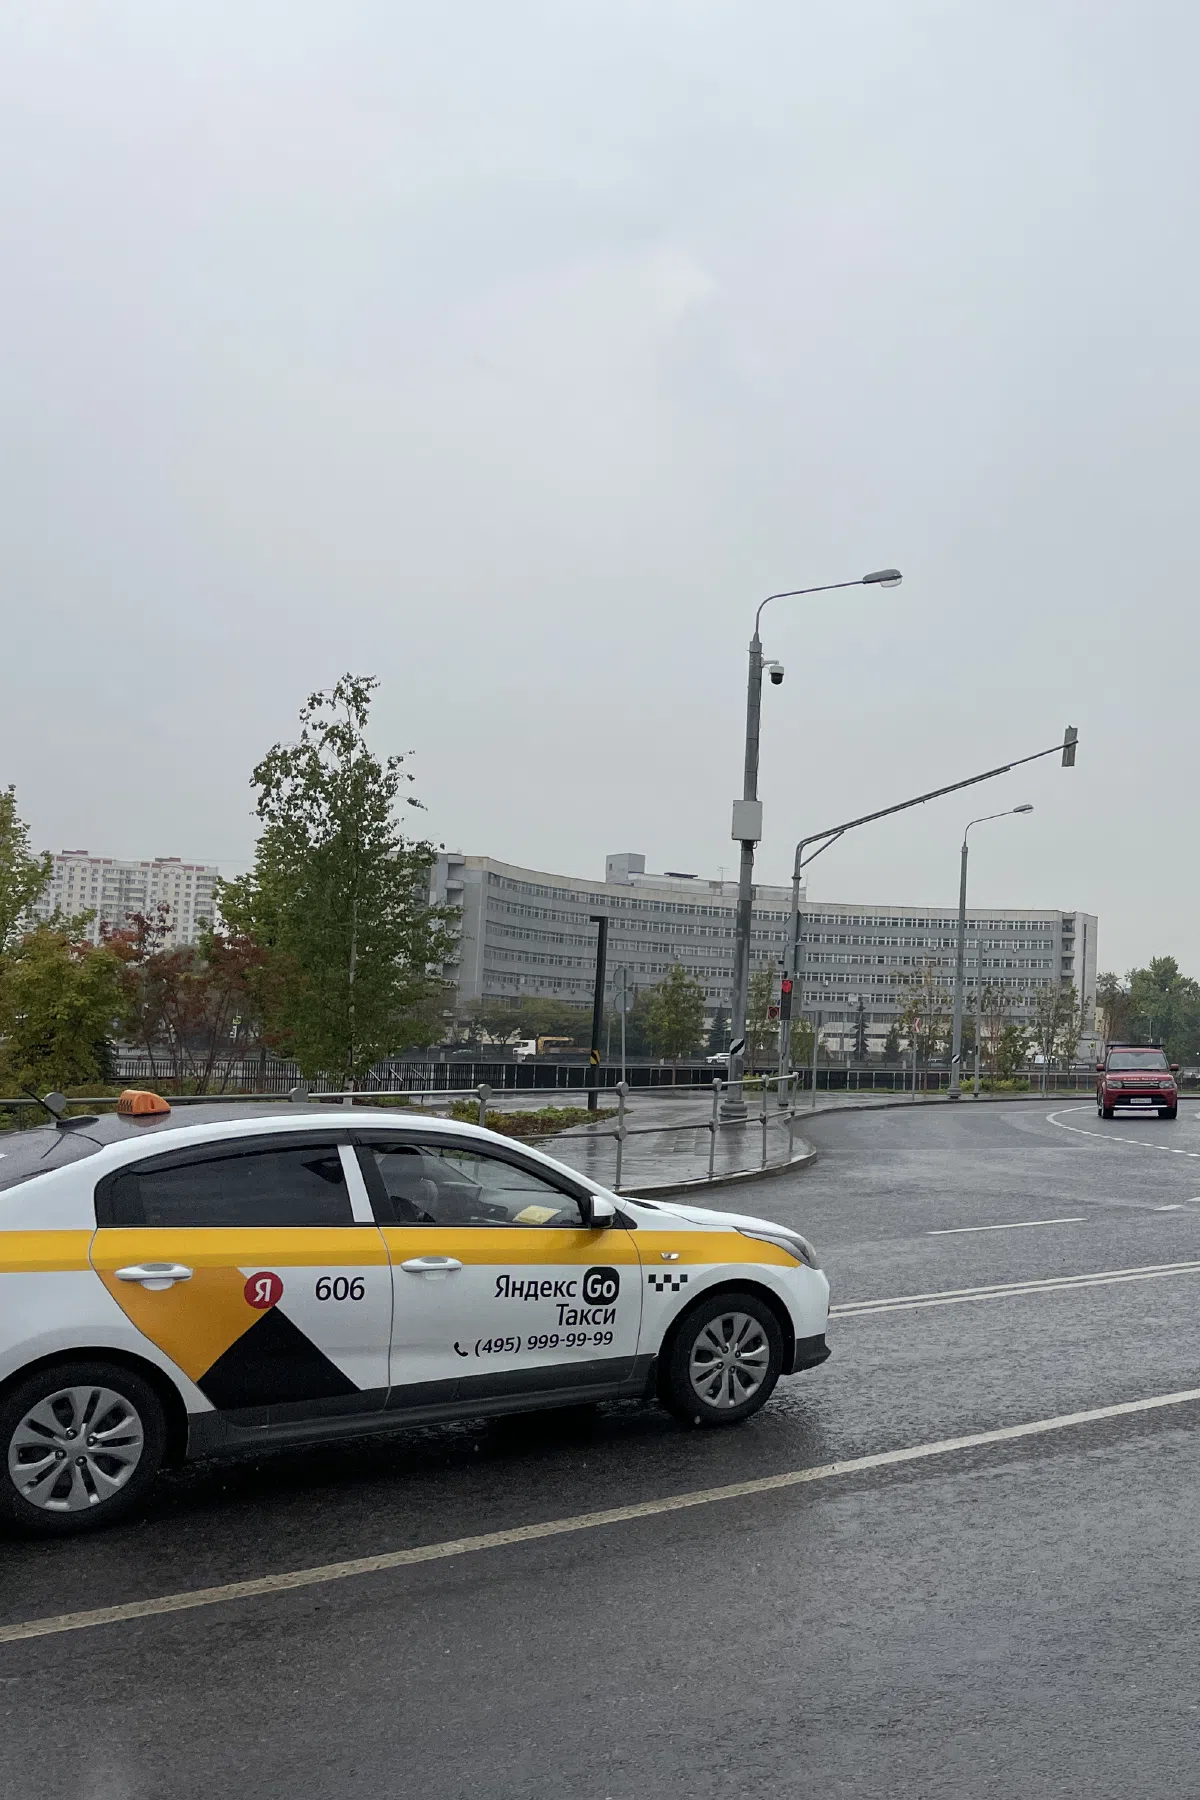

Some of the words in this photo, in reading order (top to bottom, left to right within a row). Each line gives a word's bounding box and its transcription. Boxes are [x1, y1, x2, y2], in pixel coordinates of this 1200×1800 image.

[253, 1278, 272, 1302] Я
[315, 1276, 365, 1301] 606
[494, 1274, 578, 1301] Яндекс
[586, 1274, 616, 1298] Go
[556, 1303, 617, 1326] Такси
[474, 1336, 522, 1357] (495)
[527, 1331, 614, 1350] 999-99-99
